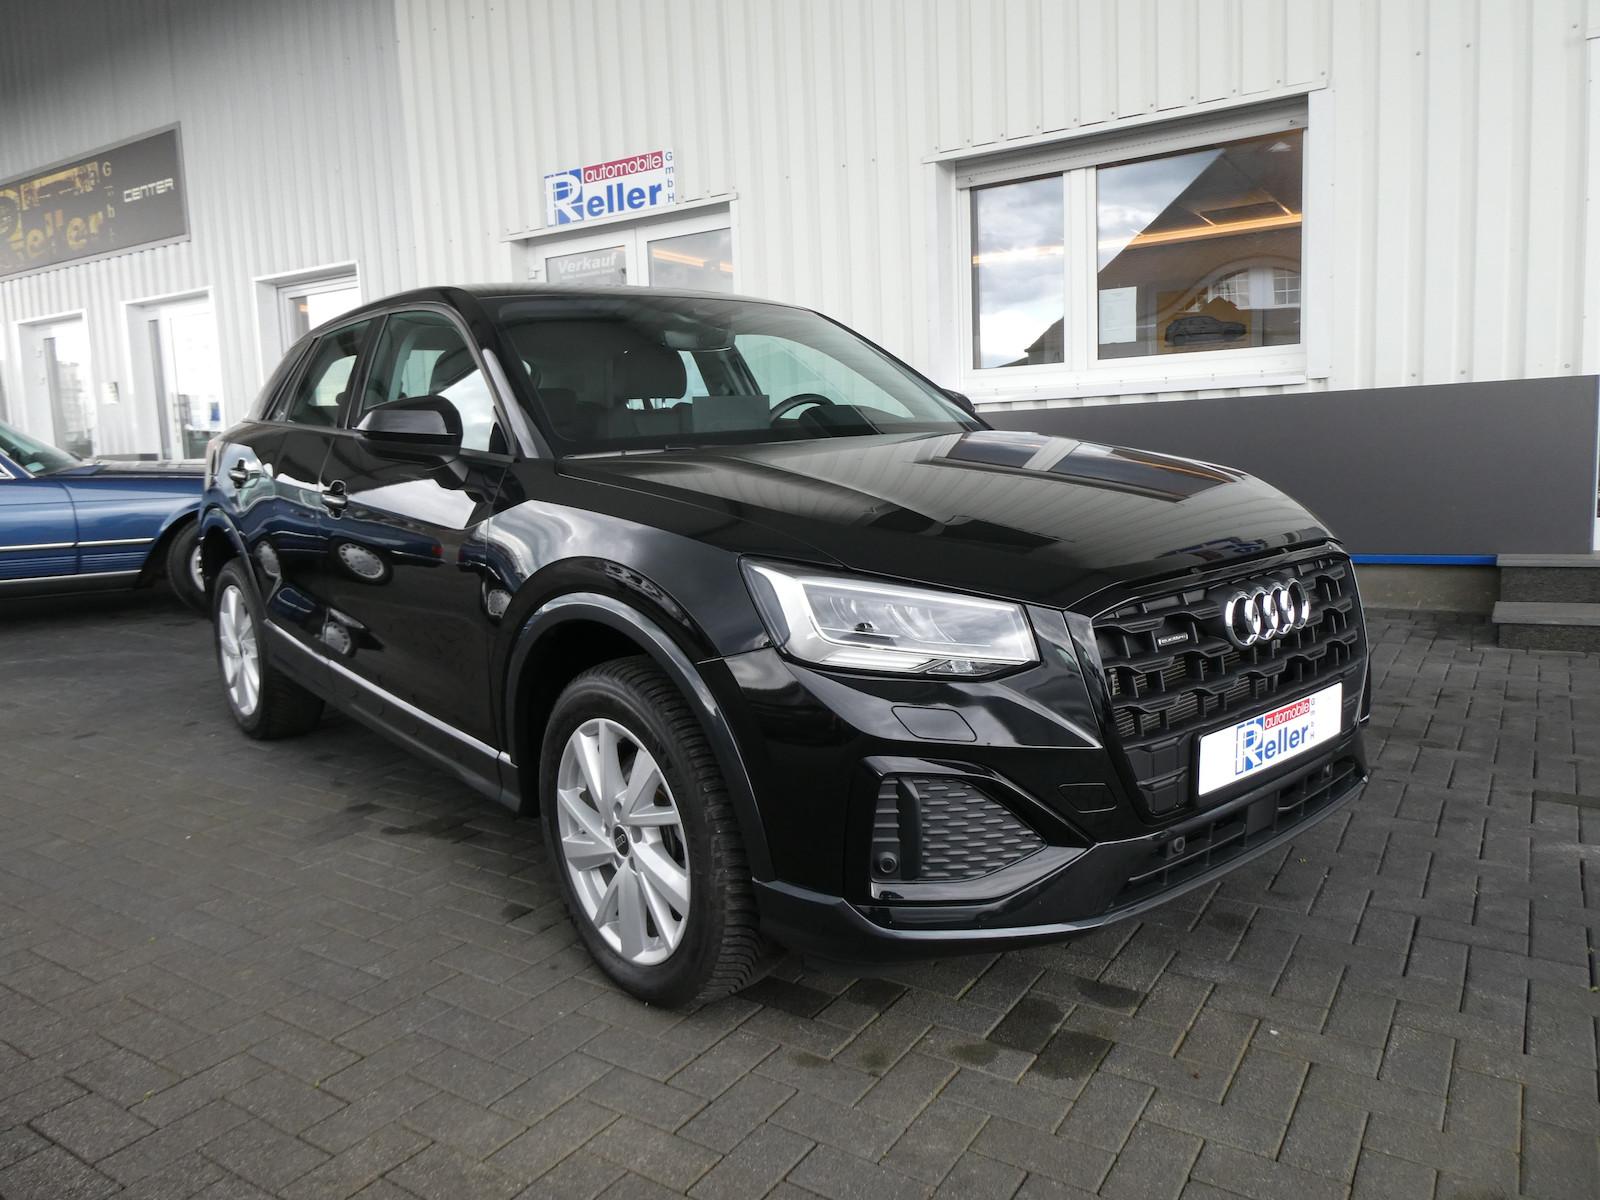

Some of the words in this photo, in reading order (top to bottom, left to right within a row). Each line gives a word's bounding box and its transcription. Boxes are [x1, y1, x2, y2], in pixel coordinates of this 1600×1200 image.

[585, 154, 662, 182] automobile
[123, 178, 174, 203] CENTER
[545, 171, 662, 226] Reller
[559, 252, 616, 274] Verkauf
[1265, 702, 1310, 729] automobile
[1235, 718, 1308, 775] Reller
